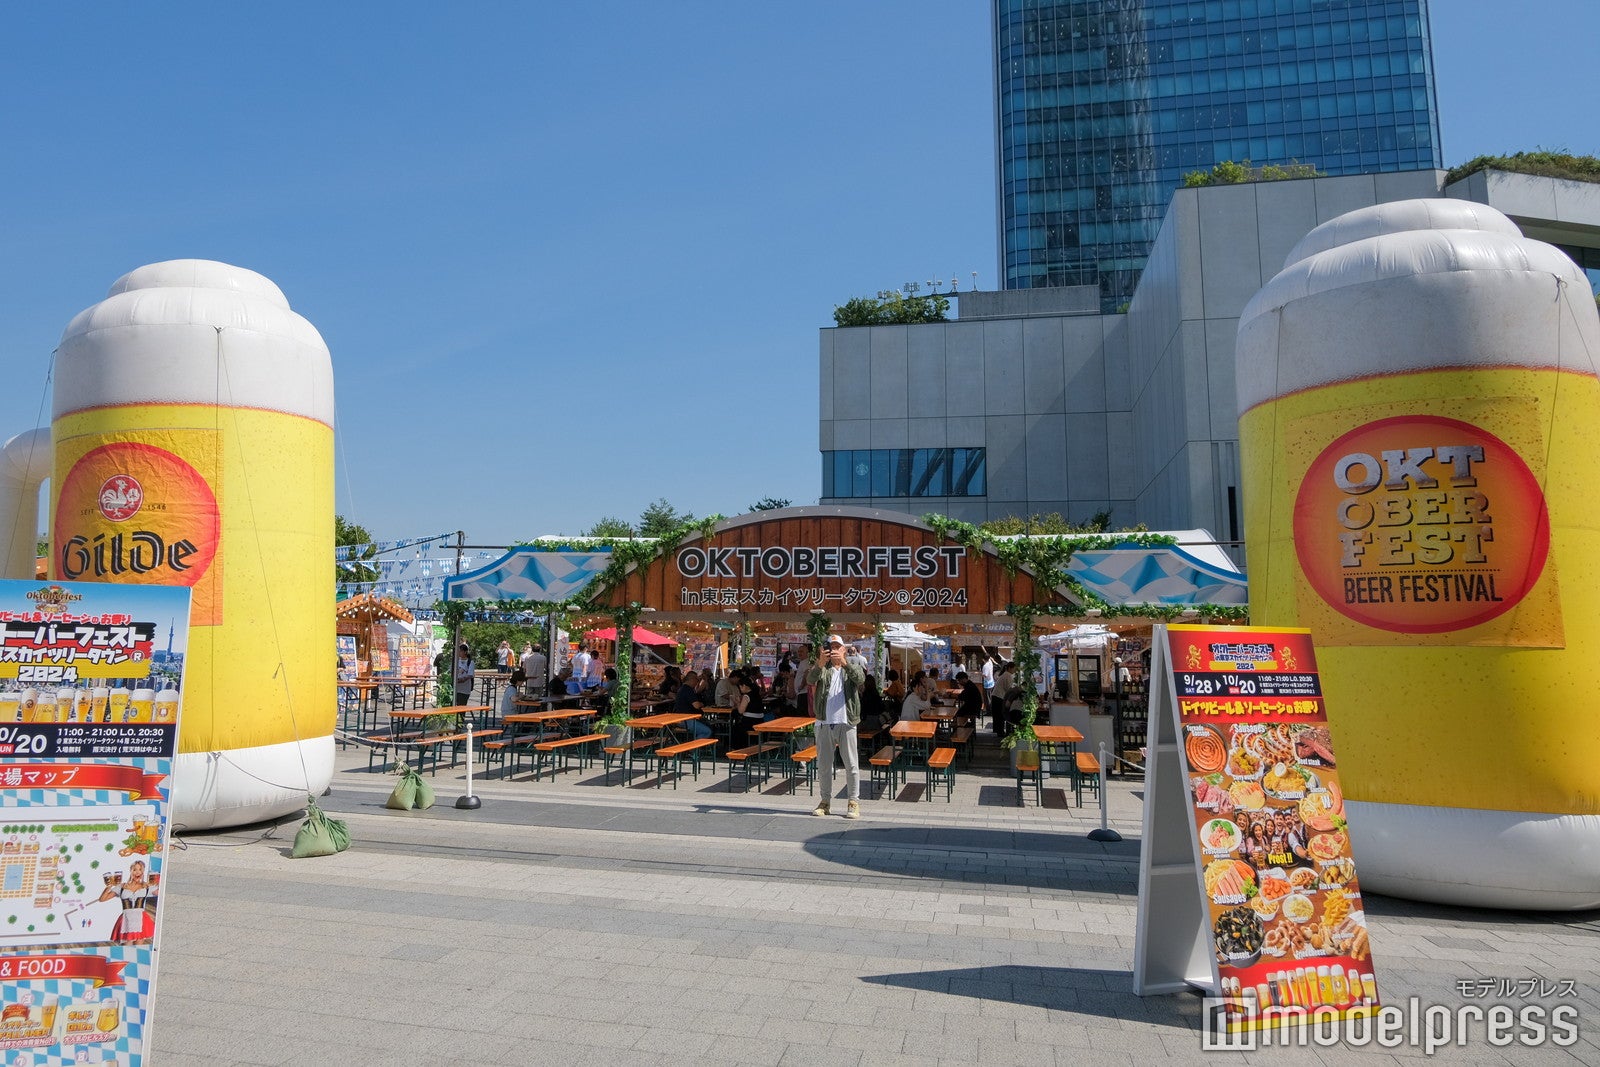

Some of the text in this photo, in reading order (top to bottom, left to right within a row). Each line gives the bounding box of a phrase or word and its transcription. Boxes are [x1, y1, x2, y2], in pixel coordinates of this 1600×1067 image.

[1333, 446, 1485, 495] OKT
[80, 508, 94, 516] SEIT
[1337, 491, 1492, 530] OBER
[1338, 526, 1494, 568] FEST
[677, 546, 966, 578] OKTOBERFEST
[26, 591, 82, 601] Oktoberfest
[1344, 574, 1503, 604] BEER FESTIVAL
[18, 665, 78, 682] 2024
[57, 728, 84, 736] 11:00
[91, 728, 118, 736] 21:00
[119, 728, 136, 736] L.O.
[138, 728, 164, 736] 20:30
[1, 959, 66, 976] & FOOD
